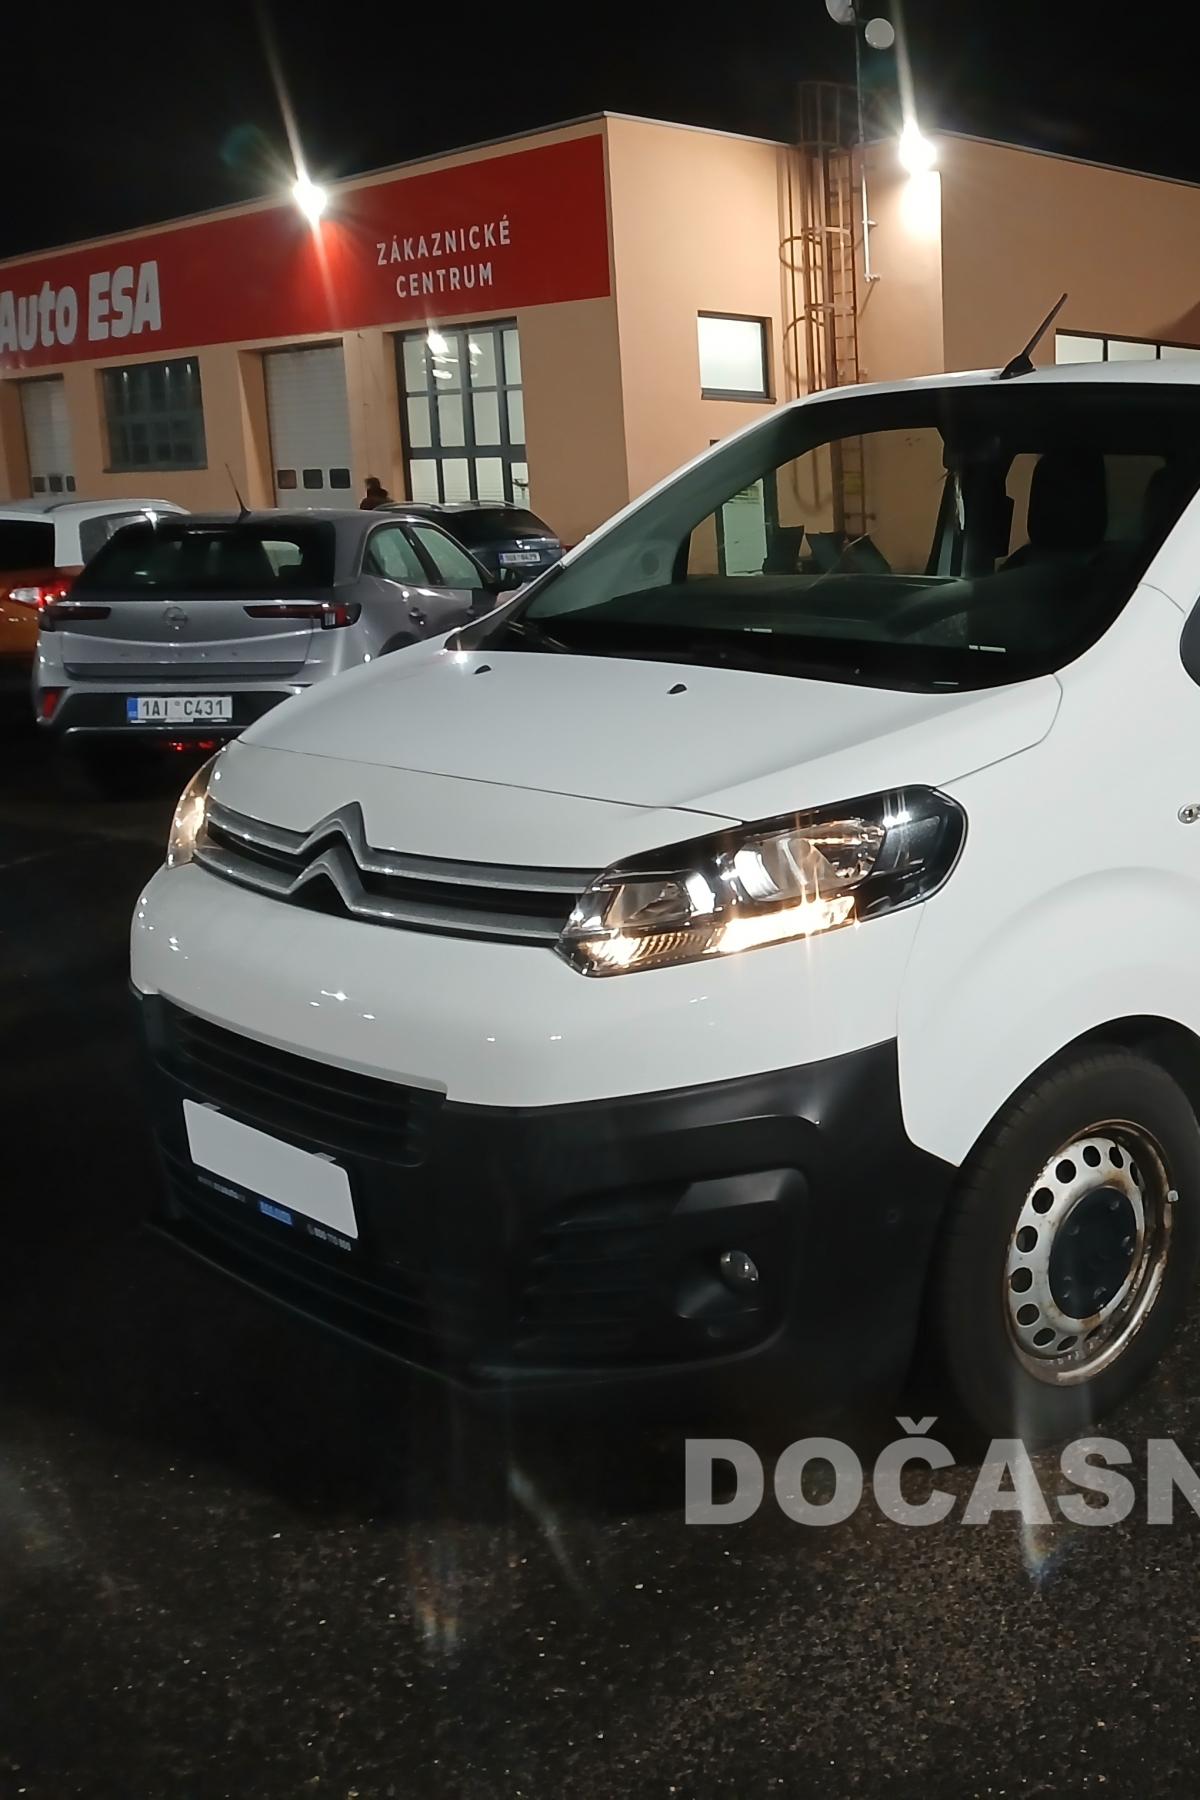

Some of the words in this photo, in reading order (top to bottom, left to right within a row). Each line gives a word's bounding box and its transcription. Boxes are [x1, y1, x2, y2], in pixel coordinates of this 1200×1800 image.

[376, 214, 511, 266] ZÁKAZNICKÉ
[396, 262, 493, 298] CENTRUM
[0, 281, 78, 351] Auto
[88, 260, 162, 341] ESA
[183, 700, 223, 716] C431
